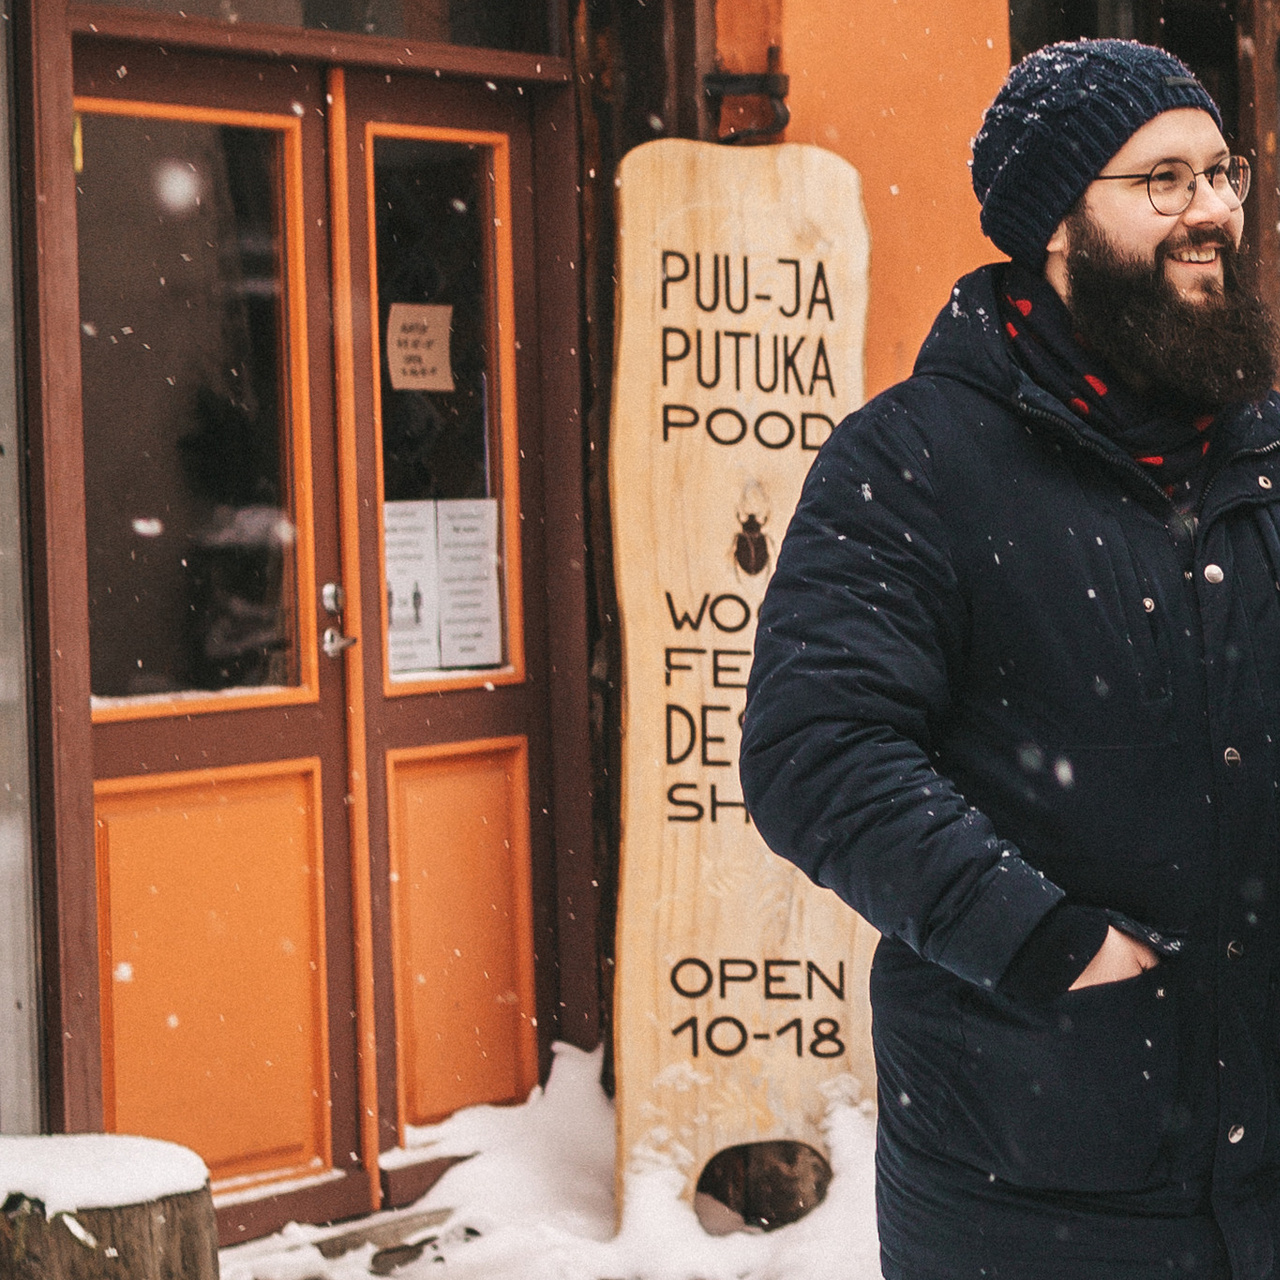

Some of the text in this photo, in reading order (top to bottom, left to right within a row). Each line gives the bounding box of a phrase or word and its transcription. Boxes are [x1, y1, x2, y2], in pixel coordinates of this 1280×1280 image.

[661, 249, 834, 321] PUU-JA
[661, 327, 836, 398] PUTUKA
[662, 404, 836, 450] POOD
[670, 957, 845, 1001] OPEN
[671, 1015, 846, 1059] 10-18
